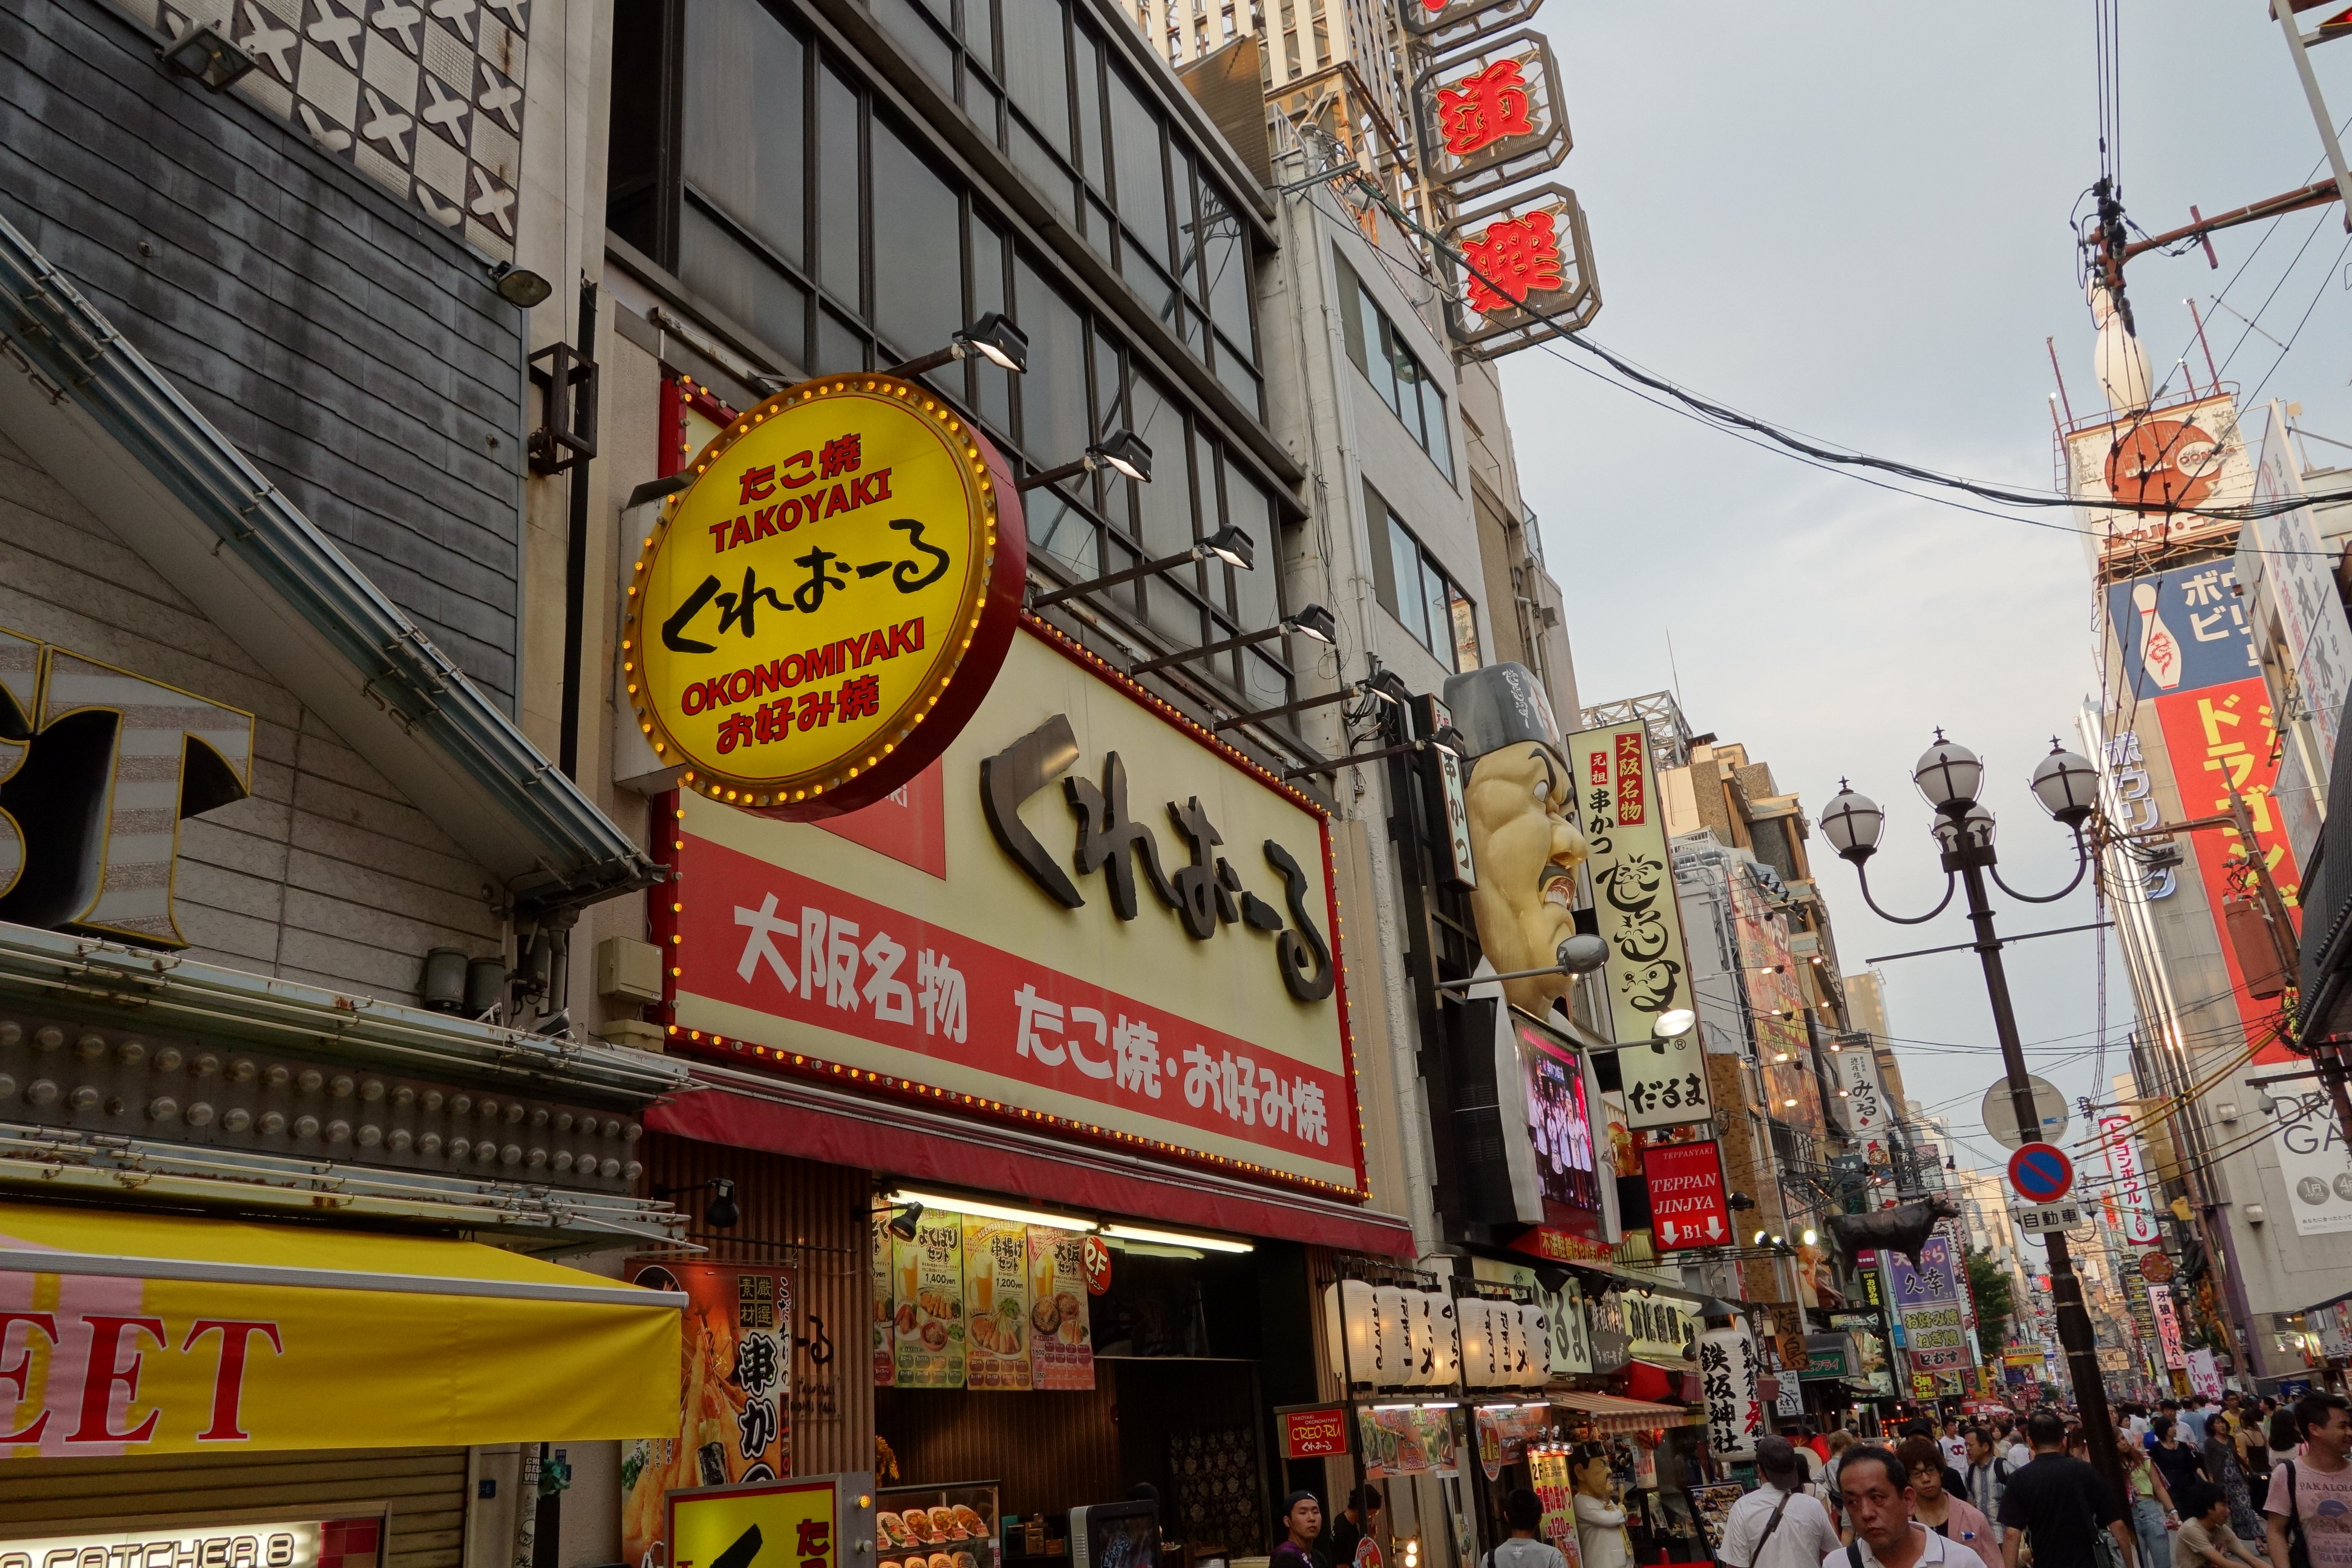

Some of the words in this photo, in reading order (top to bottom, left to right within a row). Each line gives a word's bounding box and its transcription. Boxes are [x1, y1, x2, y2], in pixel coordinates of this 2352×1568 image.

[739, 433, 862, 505] たこ焼
[709, 468, 893, 553] TAKOYAKI
[662, 518, 950, 654] くれおーる
[681, 617, 925, 716] OKONOMIYAKI
[716, 675, 879, 754] お好み焼
[1592, 753, 1607, 785] 元祖
[1618, 736, 1643, 822] 大阪名物
[1589, 788, 1615, 855] 串かつ
[981, 713, 1336, 1002] くれおーる
[734, 892, 967, 1045] 大阪名物
[1014, 984, 1328, 1148] たこ焼・お好み焼
[1628, 1073, 1705, 1114] だるま
[1852, 1080, 1877, 1117] みつる
[1663, 1148, 1713, 1160] TEPPANYAKI
[2109, 1122, 2143, 1206] ドラゴンボウル
[1651, 1173, 1717, 1193] TEPPAN
[1654, 1195, 1716, 1215] JINJYA
[2023, 1209, 2078, 1229] 自動車
[918, 1224, 959, 1250] よくばり
[990, 1232, 1025, 1261] 串揚げ
[1682, 1224, 1703, 1240] B1
[926, 1245, 950, 1264] セット
[998, 1256, 1019, 1273] セット
[1053, 1240, 1082, 1264] 大阪
[925, 1273, 956, 1285] 1,400yen
[996, 1278, 1024, 1289] 1,200yen
[1057, 1261, 1077, 1277] セット
[1905, 1308, 1961, 1329] お好み焼
[1774, 1309, 1808, 1369] 焼鳥
[1916, 1329, 1961, 1348] ねぎ焼
[1699, 1341, 1744, 1454] 鉄板神社
[1301, 1440, 1333, 1452] くれおーる
[1532, 1463, 1543, 1481] 2F
[267, 1532, 295, 1567] 8
